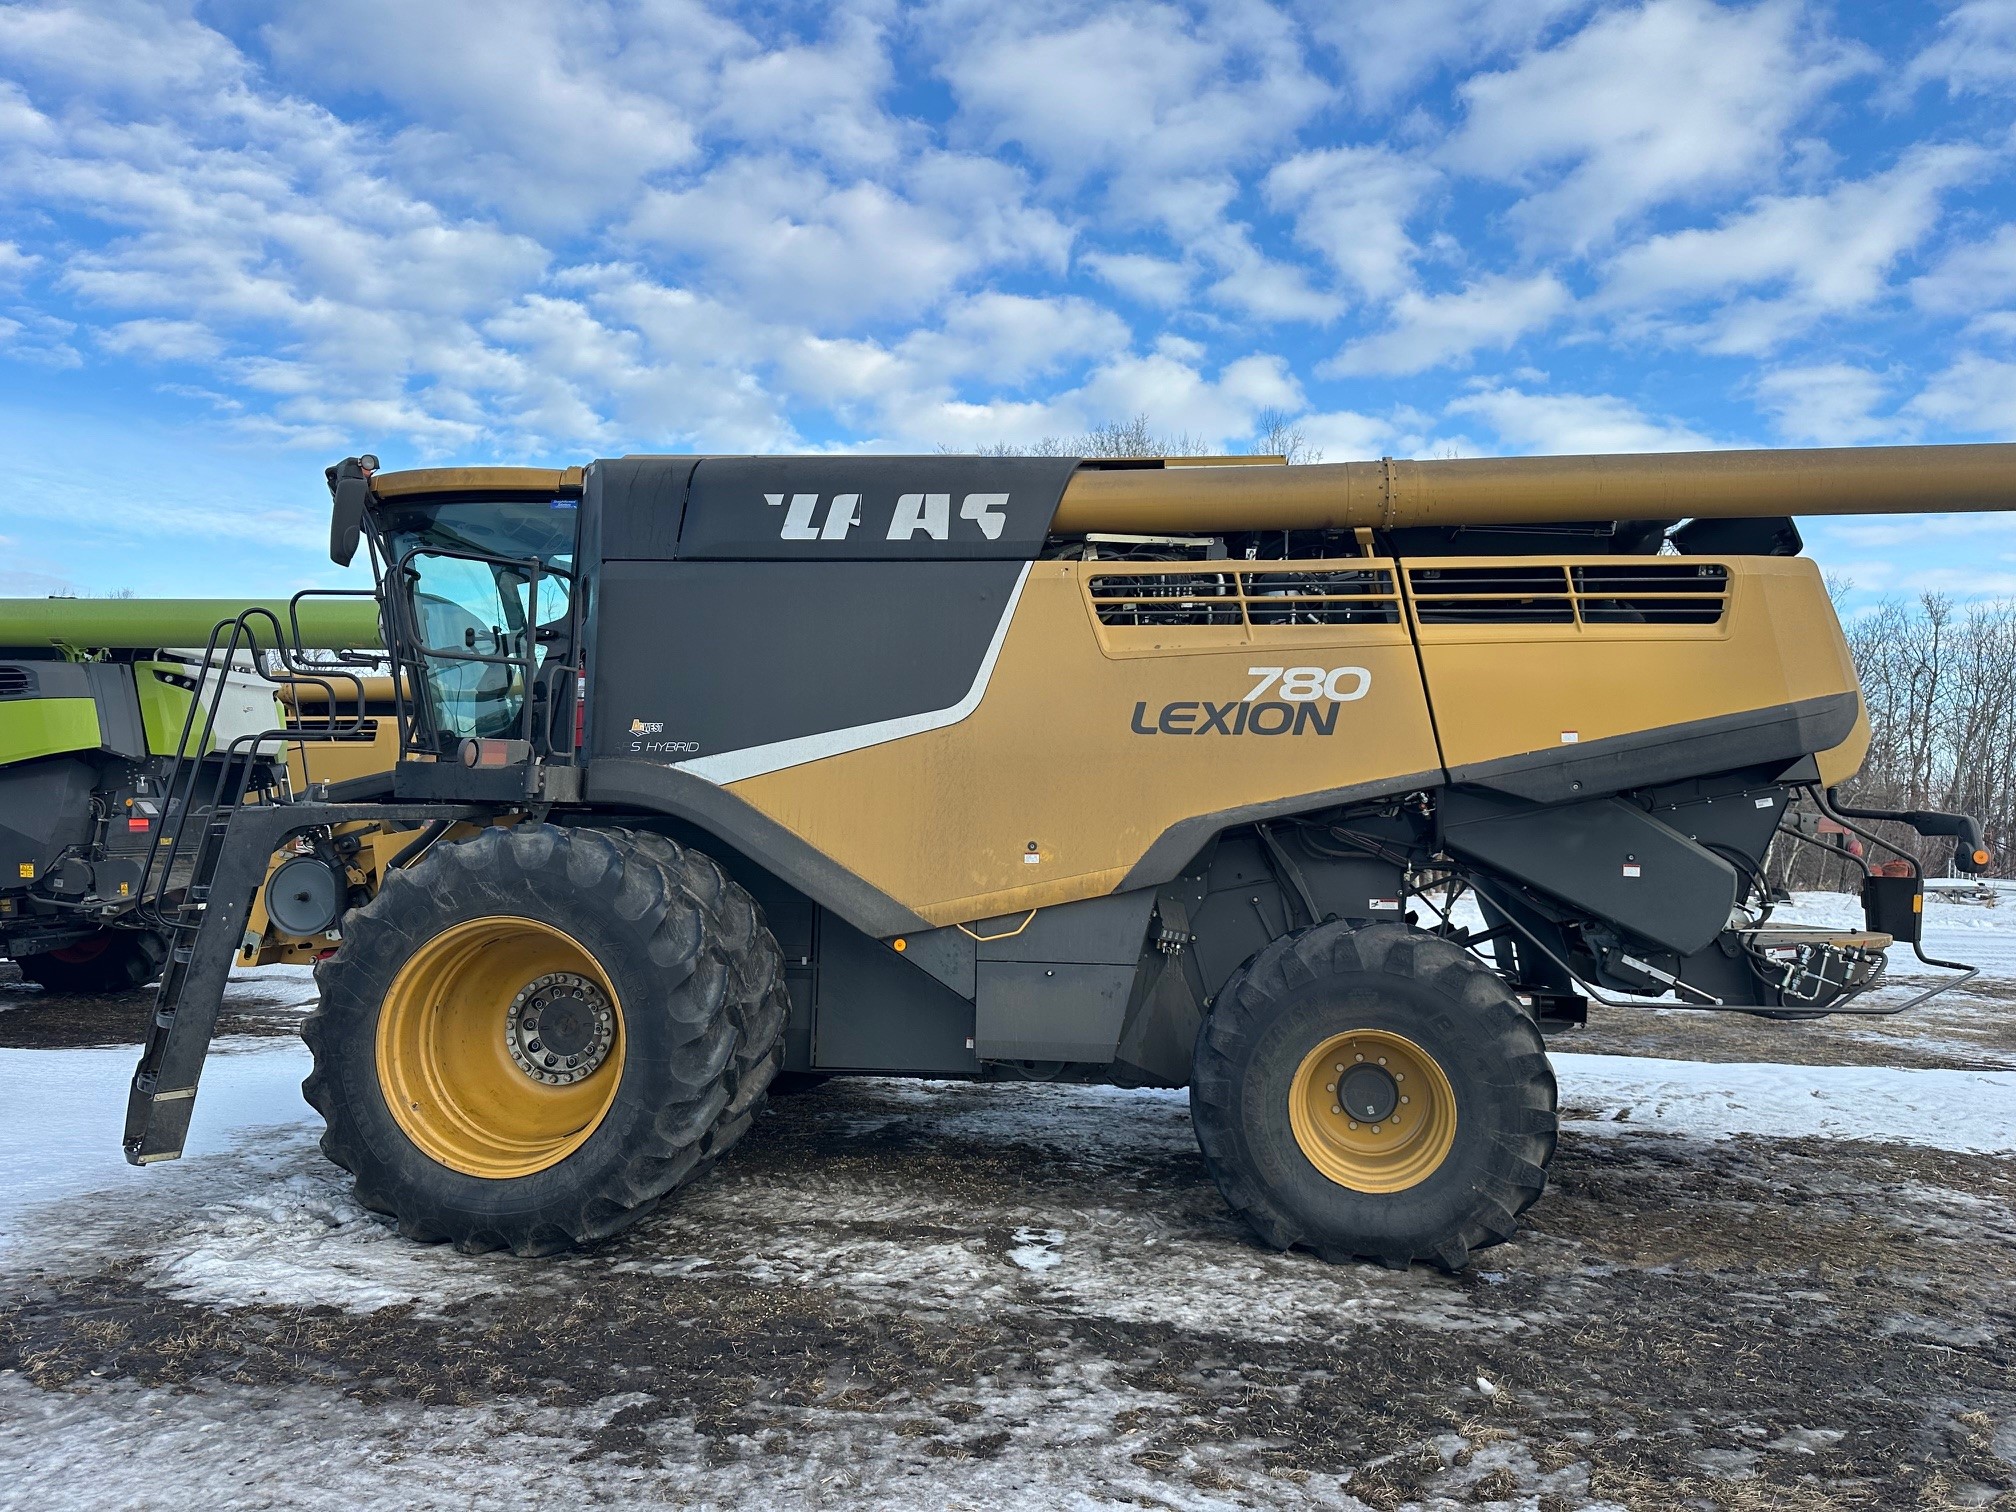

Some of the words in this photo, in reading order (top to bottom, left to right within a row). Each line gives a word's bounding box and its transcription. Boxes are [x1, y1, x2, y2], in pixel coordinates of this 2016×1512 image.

[763, 493, 1010, 540] LAAS
[1243, 667, 1372, 701] 780
[1131, 701, 1341, 735] LEXION
[646, 741, 700, 752] HYBRID
